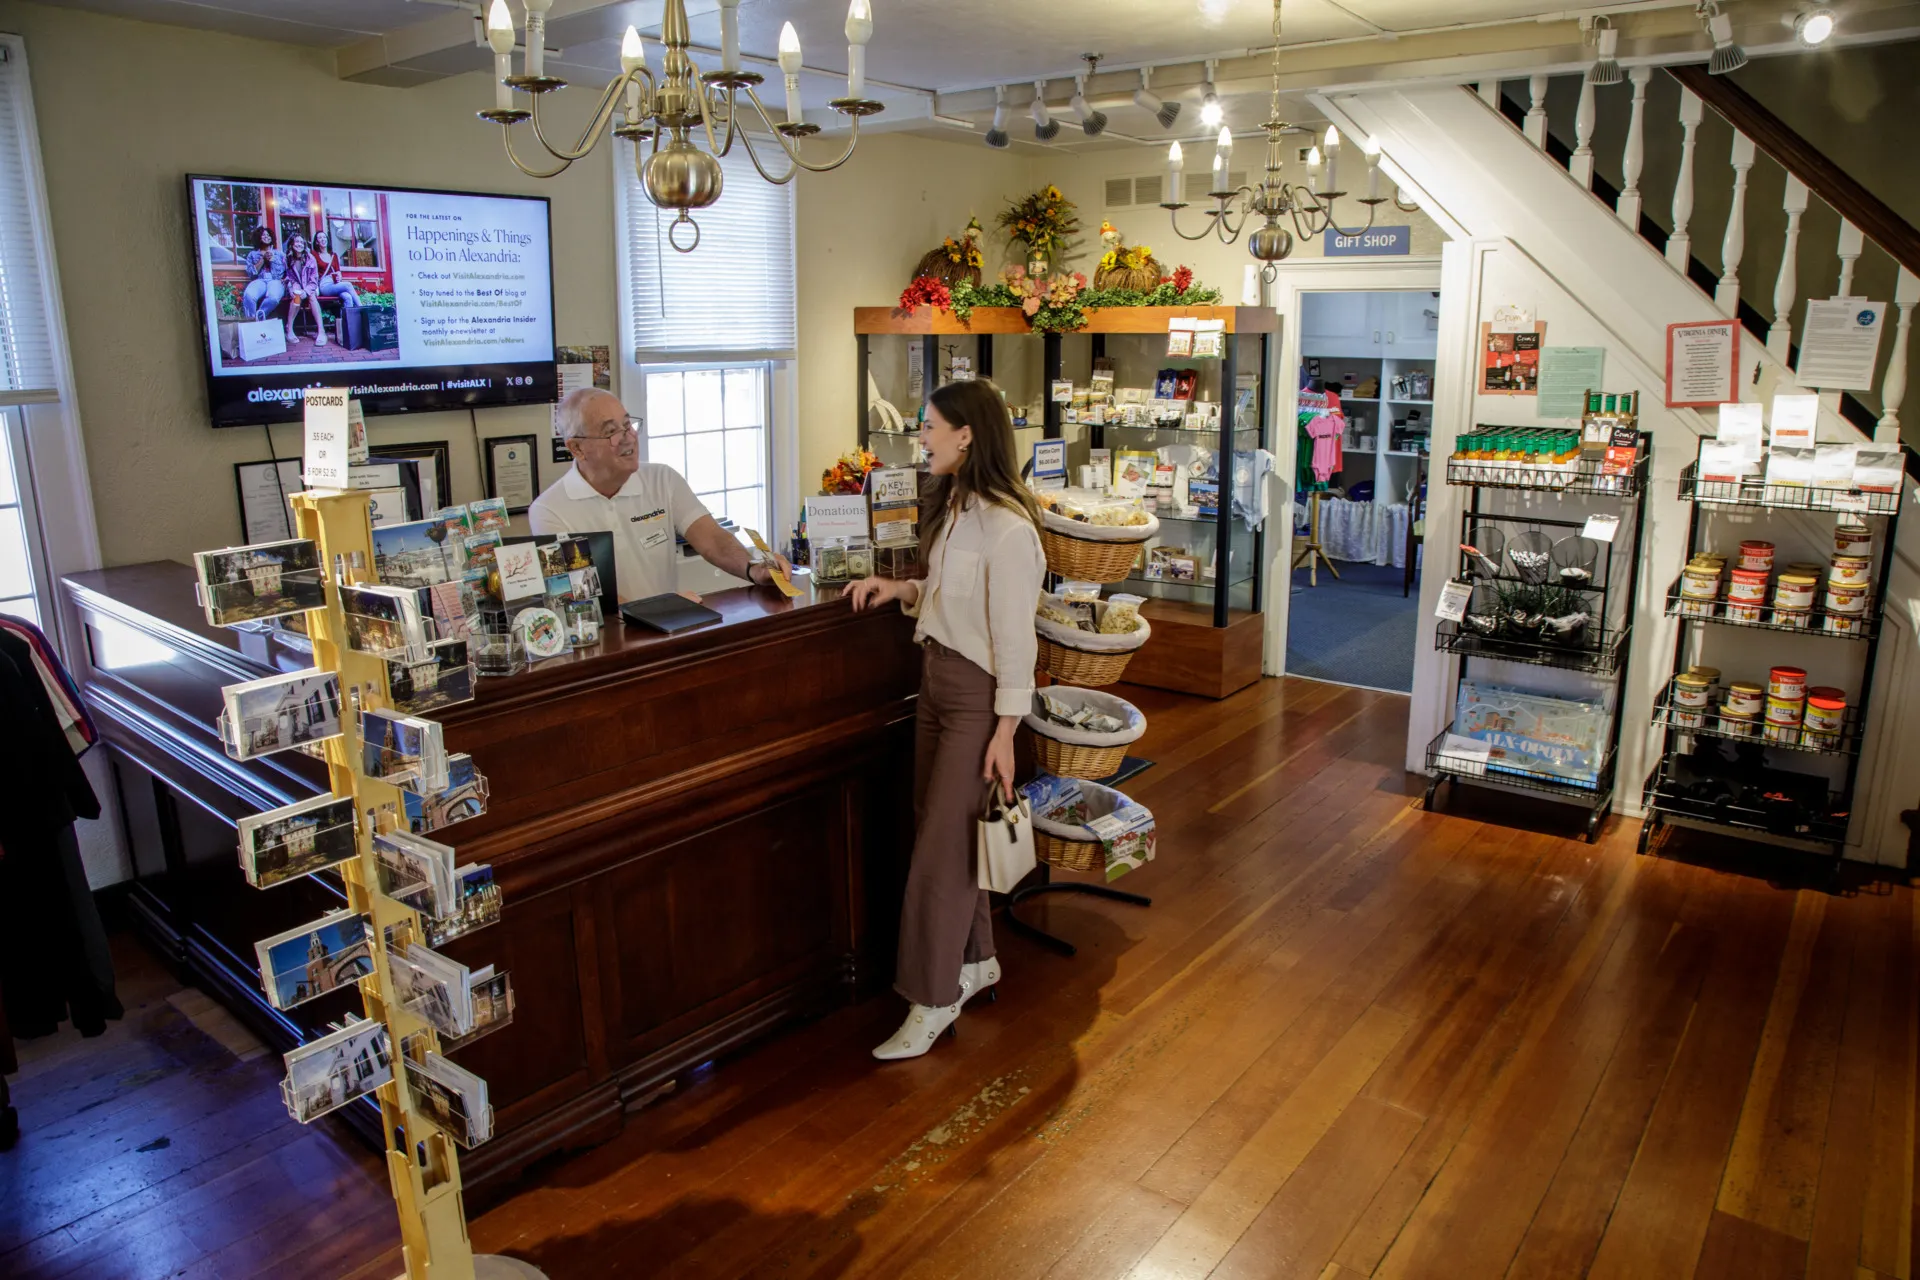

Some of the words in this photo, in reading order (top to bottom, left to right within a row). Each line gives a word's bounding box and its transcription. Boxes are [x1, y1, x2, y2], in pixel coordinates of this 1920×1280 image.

[407, 225, 480, 245] Happenings
[481, 228, 493, 243] &
[493, 229, 532, 247] Things
[1334, 235, 1360, 248] GIFT
[1363, 234, 1397, 247] SHOP
[409, 249, 422, 261] to
[424, 247, 444, 262] Do
[445, 248, 457, 262] in
[458, 248, 521, 263] Alexandria:
[417, 271, 438, 280] Check
[440, 272, 451, 280] out
[453, 272, 525, 280] VisitAlexandria.com
[419, 289, 434, 298] Stay
[436, 289, 454, 297] tuned
[464, 289, 475, 297] the
[476, 289, 492, 297] Best
[494, 289, 504, 297] Of
[504, 289, 519, 298] blog
[420, 299, 522, 308] VisitAlexandria.com/BestOf
[421, 317, 436, 327] Sign
[438, 318, 446, 326] up
[447, 316, 458, 325] for
[459, 317, 470, 325] the
[471, 316, 511, 324] Alexandria
[513, 316, 537, 324] Insider
[422, 328, 448, 337] monthly
[450, 328, 487, 336] e-newsletter
[1707, 327, 1729, 337] DINER
[423, 338, 524, 346] VisitAlexandria.com/eNews
[446, 378, 486, 389] #visitALX
[305, 396, 344, 407] POSTCARDS
[320, 432, 335, 441] EACH
[318, 450, 327, 459] OR
[307, 467, 311, 476] 5
[312, 467, 322, 476] FOR
[888, 480, 904, 490] KEY
[897, 487, 915, 497] CITY
[630, 508, 665, 522] alexandria
[808, 504, 866, 518] Donations
[1483, 732, 1577, 762] ALX-OPOLY
